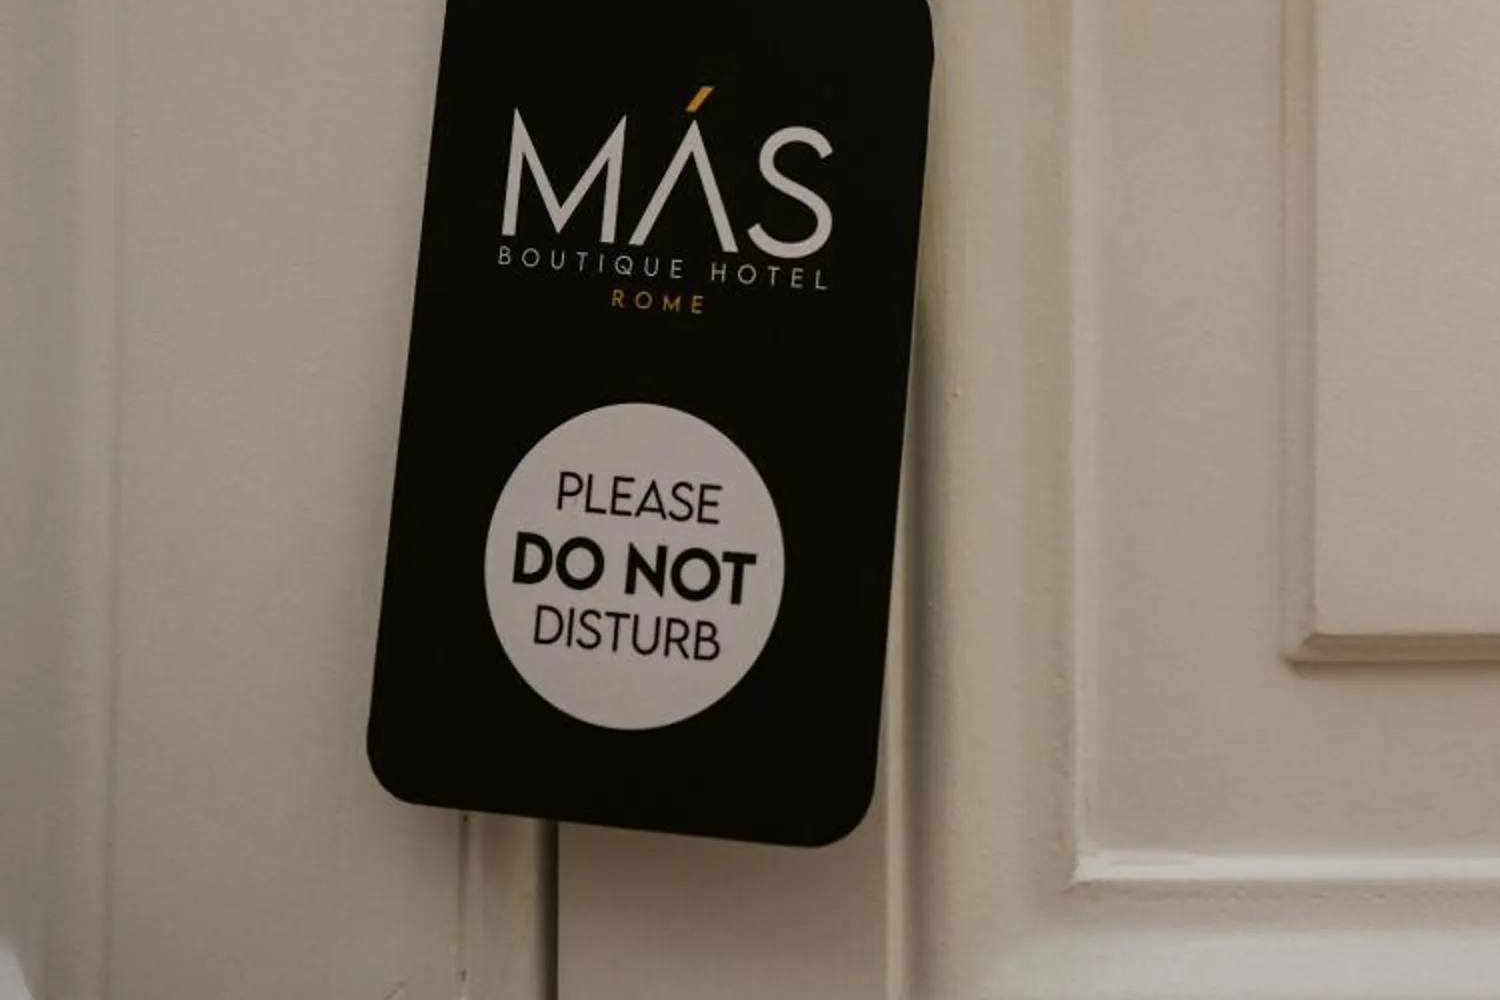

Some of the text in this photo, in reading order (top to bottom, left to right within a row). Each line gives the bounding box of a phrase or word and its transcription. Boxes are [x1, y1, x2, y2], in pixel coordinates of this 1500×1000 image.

[501, 86, 834, 259] MÁS
[497, 245, 829, 291] BOUTIQUE HOTEL
[611, 289, 705, 315] ROME
[556, 470, 724, 526] PLEASE
[511, 530, 758, 606] DO NOT
[532, 603, 722, 662] DISTURB
